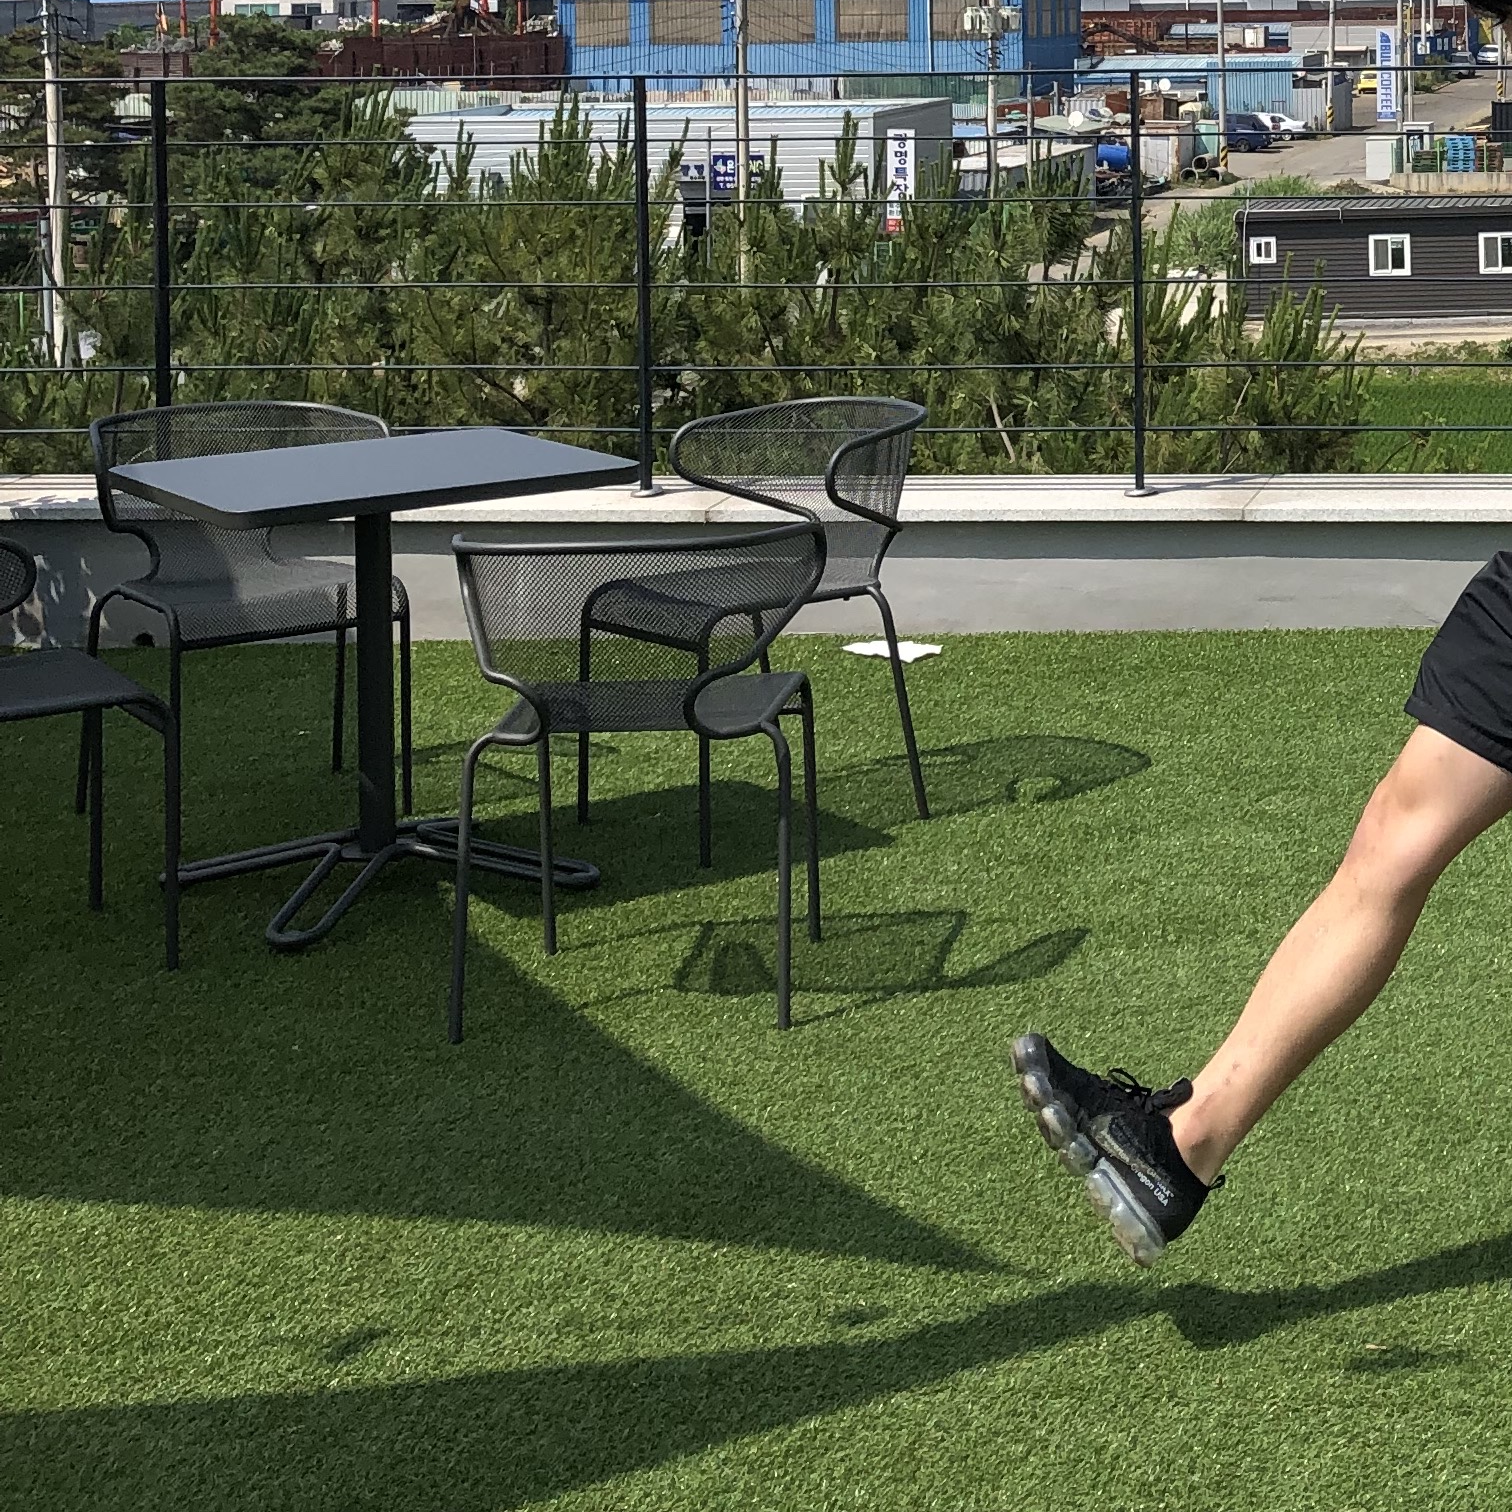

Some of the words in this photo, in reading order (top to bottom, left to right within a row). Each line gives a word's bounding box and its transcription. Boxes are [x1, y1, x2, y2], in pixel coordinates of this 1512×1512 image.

[1380, 44, 1391, 67] BUL
[1380, 72, 1392, 111] COFFEE
[1153, 1188, 1169, 1207] USA
